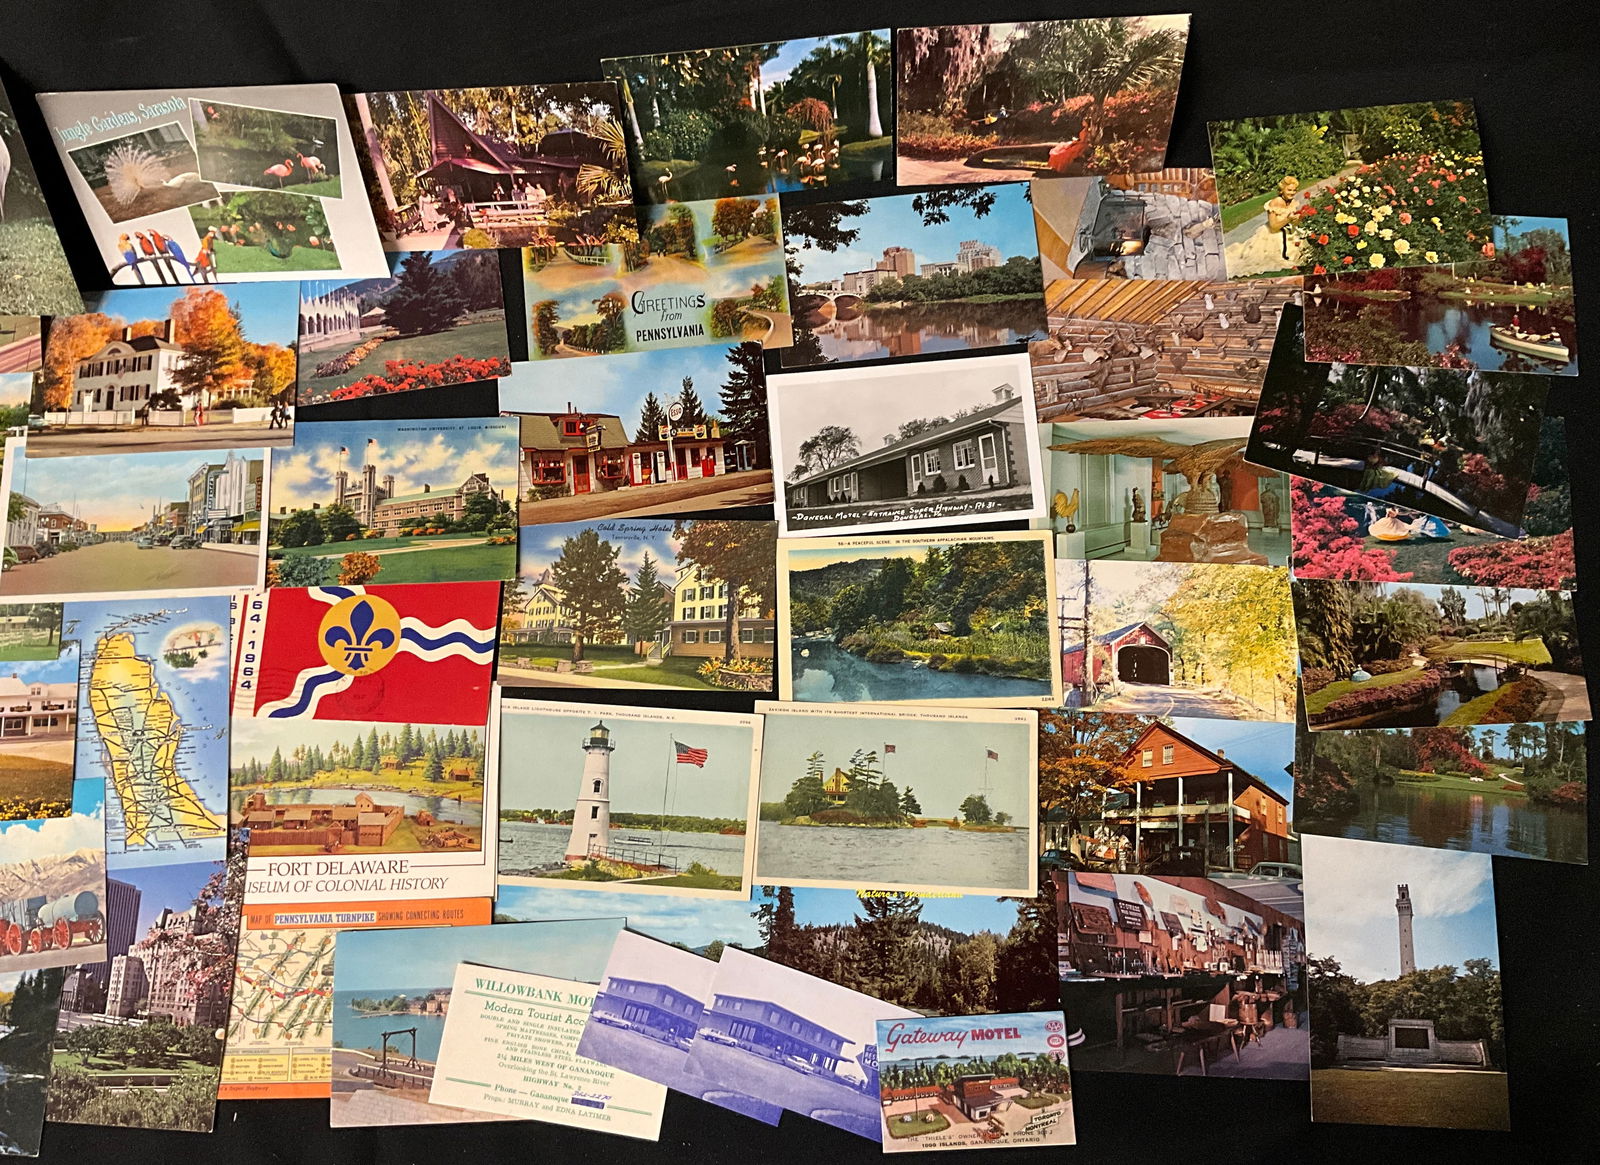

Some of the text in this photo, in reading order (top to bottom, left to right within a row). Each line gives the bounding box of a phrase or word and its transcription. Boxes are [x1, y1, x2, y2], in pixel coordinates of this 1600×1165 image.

[55, 96, 187, 146] Jungle Gardens, Sarasota
[661, 309, 682, 322] from
[636, 323, 704, 342] PENNSYLVANIA
[835, 511, 860, 519] MOTEL
[909, 506, 934, 514] SUPER
[597, 523, 673, 533] Cold Spring Hotel
[240, 640, 256, 689] 1964
[268, 859, 409, 876] FORT DELAWARE
[244, 877, 448, 893] USEUM OF COLONIAL HISTORY
[250, 908, 464, 924] MAP OF PENNSYLVANIA TURNPIKE SHOWING CONNECTING ROUTES
[475, 977, 563, 1002] WILLOWBANK
[484, 1000, 523, 1016] Modern
[528, 1007, 563, 1022] Tourist
[480, 1013, 504, 1022] DOUBLE
[523, 1021, 545, 1029] SINGLE
[547, 1024, 580, 1035] INSULATED
[496, 1024, 517, 1032] SPRING
[502, 1040, 528, 1048] ENGLISH
[506, 1032, 532, 1040] PRIVATE
[885, 1023, 1021, 1053] Gateway MOTEL
[520, 1048, 552, 1058] STAINLESS
[498, 1061, 537, 1075] Overlooking
[560, 1072, 591, 1083] Lawrence
[592, 1078, 610, 1086] River
[510, 1055, 533, 1064] MILES
[535, 1059, 555, 1068] WEST
[569, 1065, 615, 1079] GANANOQUE
[523, 1075, 559, 1087] HIGHWAY
[494, 1083, 569, 1103] Phone Gananoque
[508, 1097, 540, 1109] MURRAY
[541, 1104, 554, 1112] and
[556, 1105, 576, 1115] EDNA
[578, 1110, 611, 1121] LATIMER
[1034, 1111, 1061, 1121] TORONTO
[1025, 1118, 1056, 1132] MONTREAL
